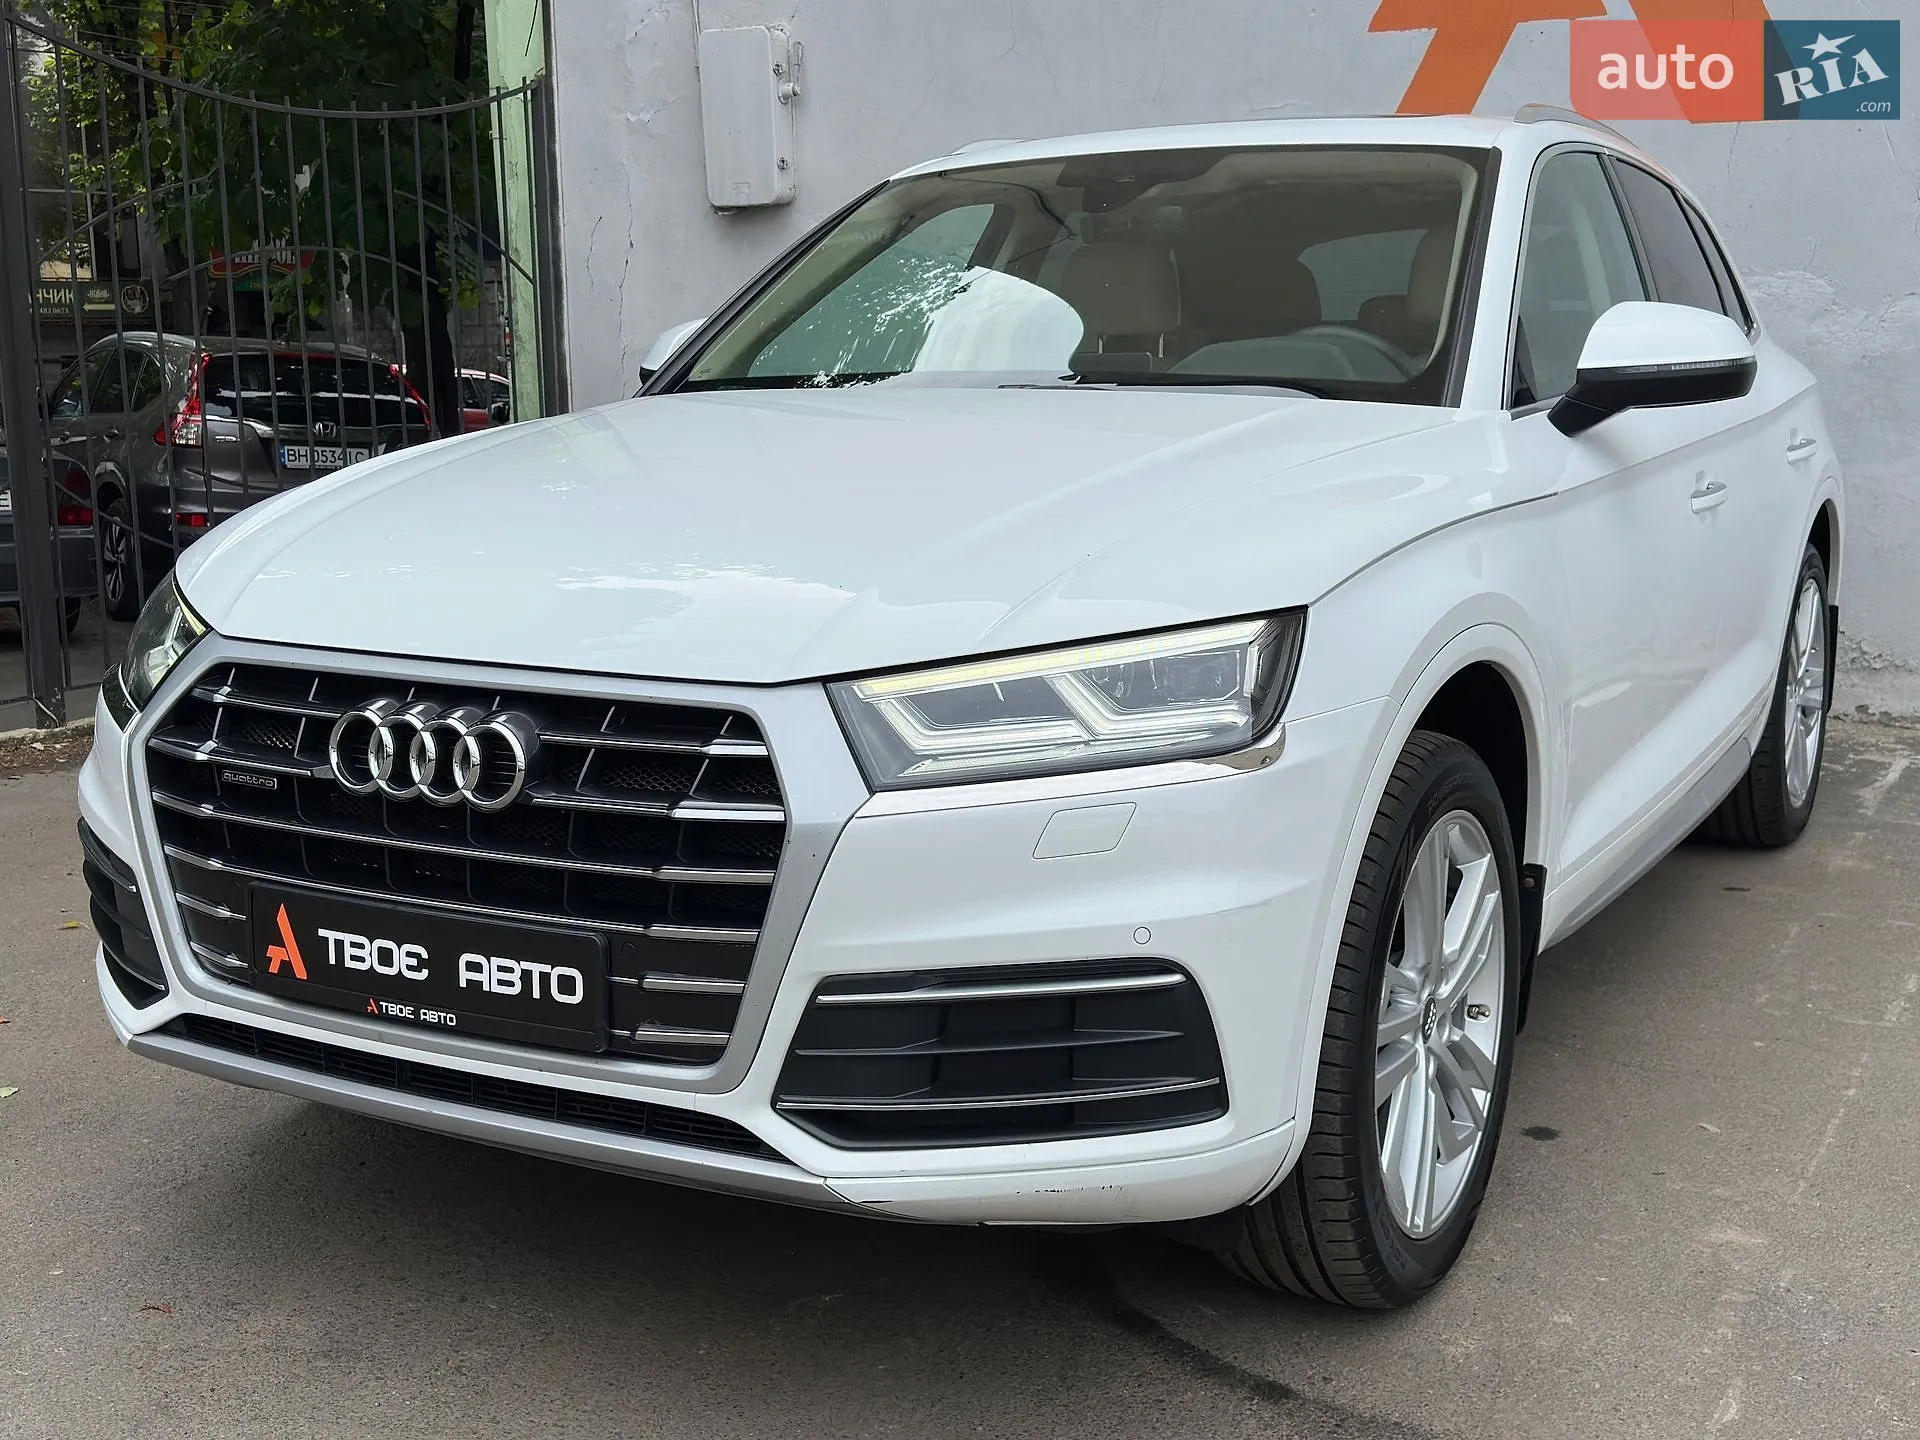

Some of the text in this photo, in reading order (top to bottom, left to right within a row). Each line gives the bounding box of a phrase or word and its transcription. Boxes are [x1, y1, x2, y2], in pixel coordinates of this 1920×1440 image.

[223, 772, 274, 787] quattro
[458, 952, 584, 1005] АВТО
[419, 1008, 457, 1026] АВТО
